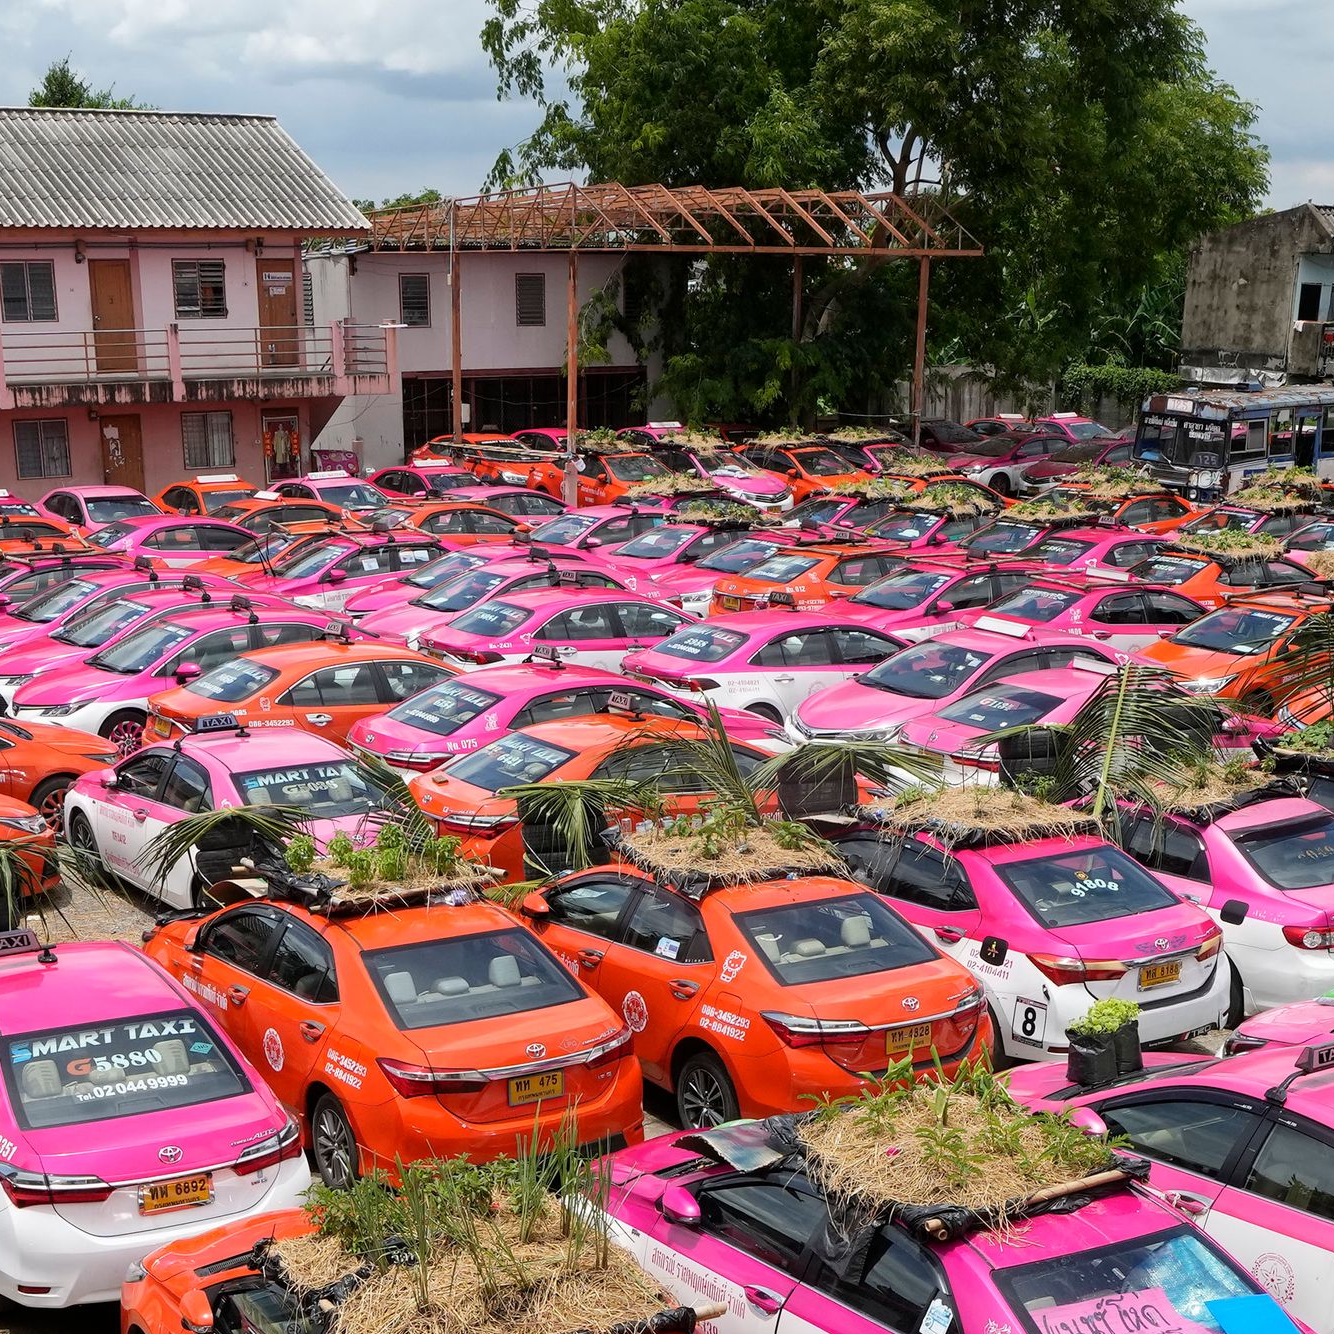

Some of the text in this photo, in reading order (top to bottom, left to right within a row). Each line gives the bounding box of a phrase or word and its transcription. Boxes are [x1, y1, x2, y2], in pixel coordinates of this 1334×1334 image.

[611, 694, 629, 705] TAXI
[204, 716, 233, 728] TAXI
[446, 738, 478, 752] No. 075
[243, 768, 309, 790] SMART
[1070, 877, 1120, 898] 91808
[701, 1004, 751, 1030] 086-3452293
[1023, 1007, 1037, 1037] 8
[699, 1017, 747, 1042] 02-8841922
[11, 1018, 197, 1064] SMART TAXI
[327, 1048, 367, 1078] 086-3452293
[324, 1061, 363, 1090] 02-8841922
[539, 1074, 558, 1088] 475
[175, 1178, 206, 1195] 6892
